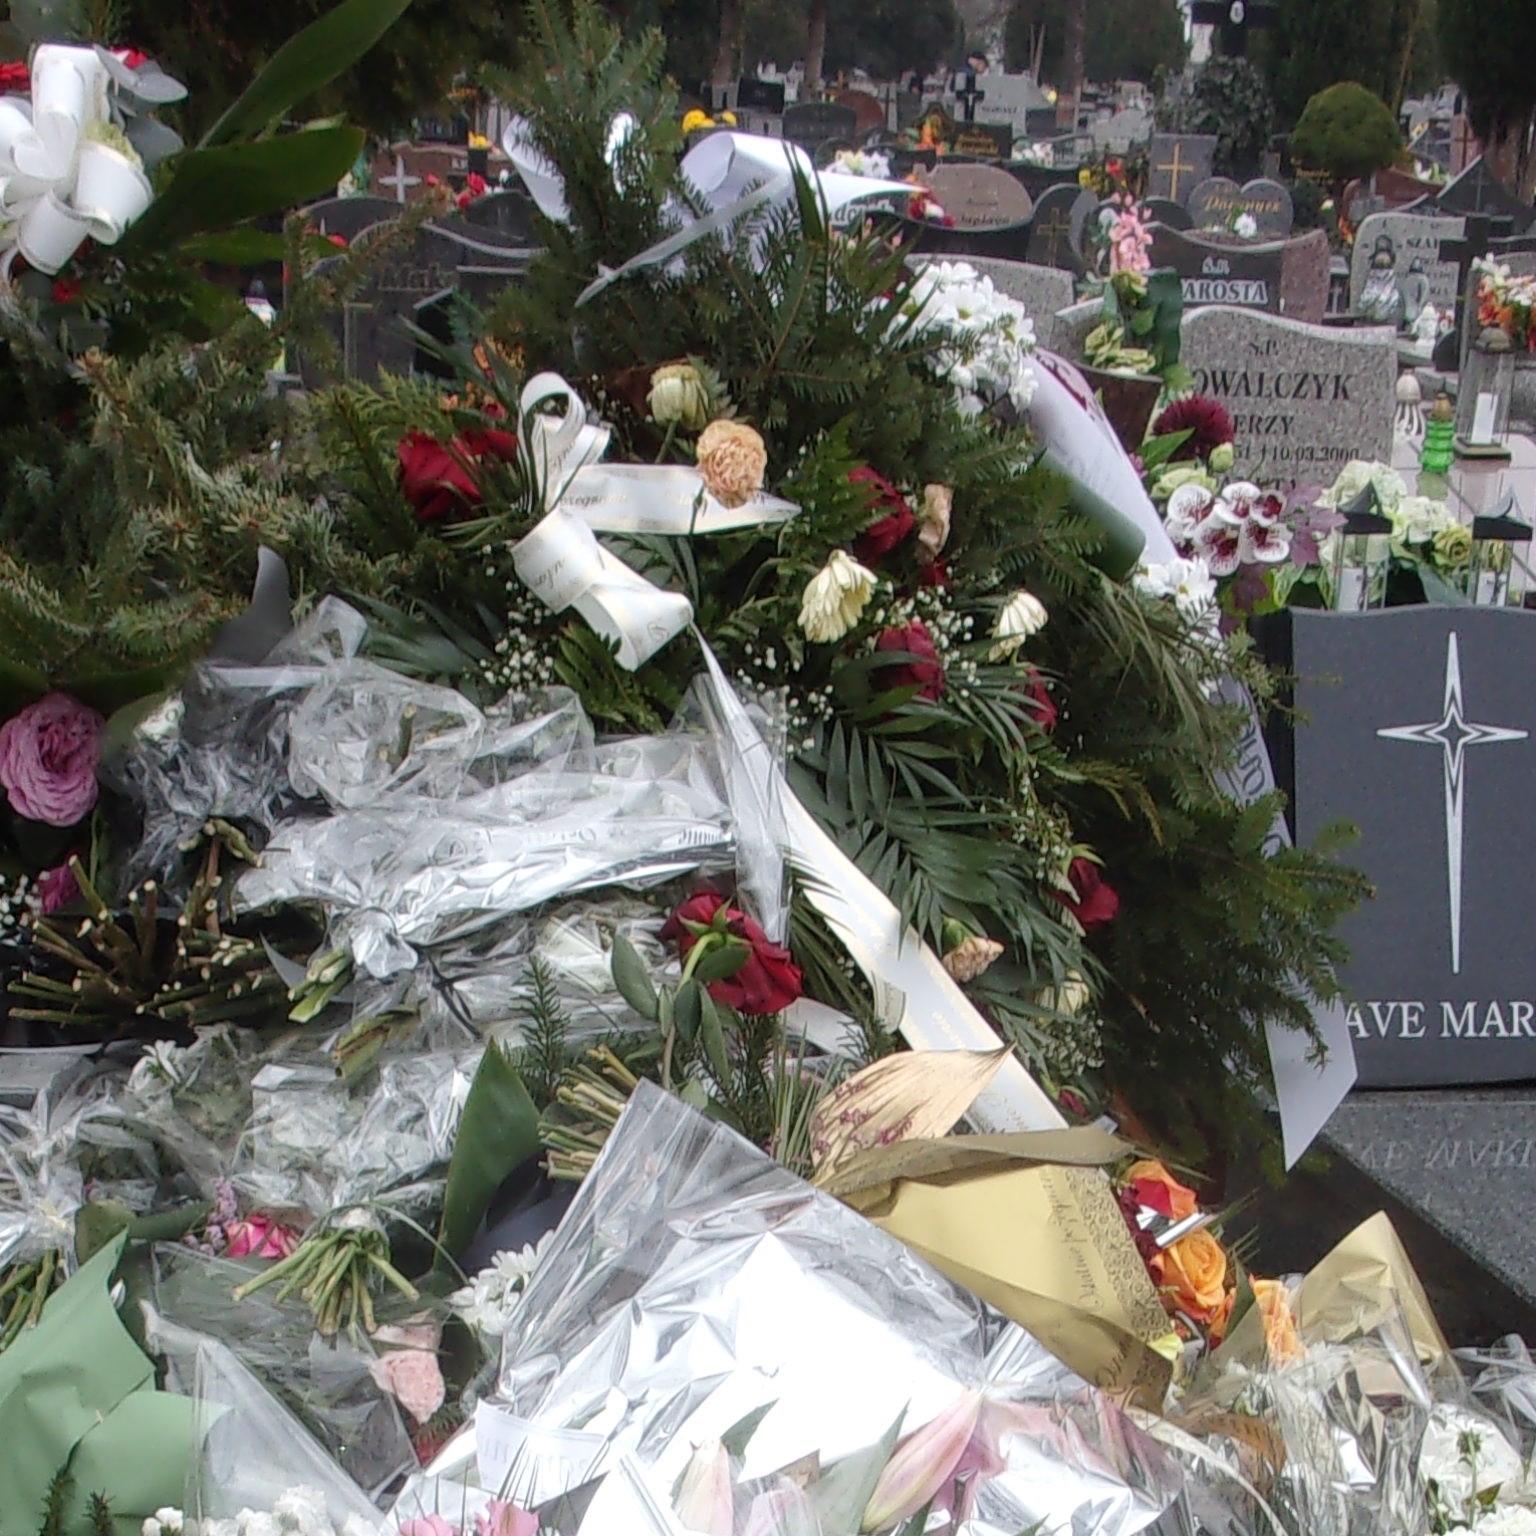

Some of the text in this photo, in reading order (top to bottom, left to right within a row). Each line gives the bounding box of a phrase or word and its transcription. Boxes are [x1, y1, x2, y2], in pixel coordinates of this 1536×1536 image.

[1181, 279, 1267, 303] AROSTA
[1192, 368, 1355, 400] OWALCZYK
[1231, 415, 1295, 436] ERZY
[1344, 1001, 1426, 1039] AVE
